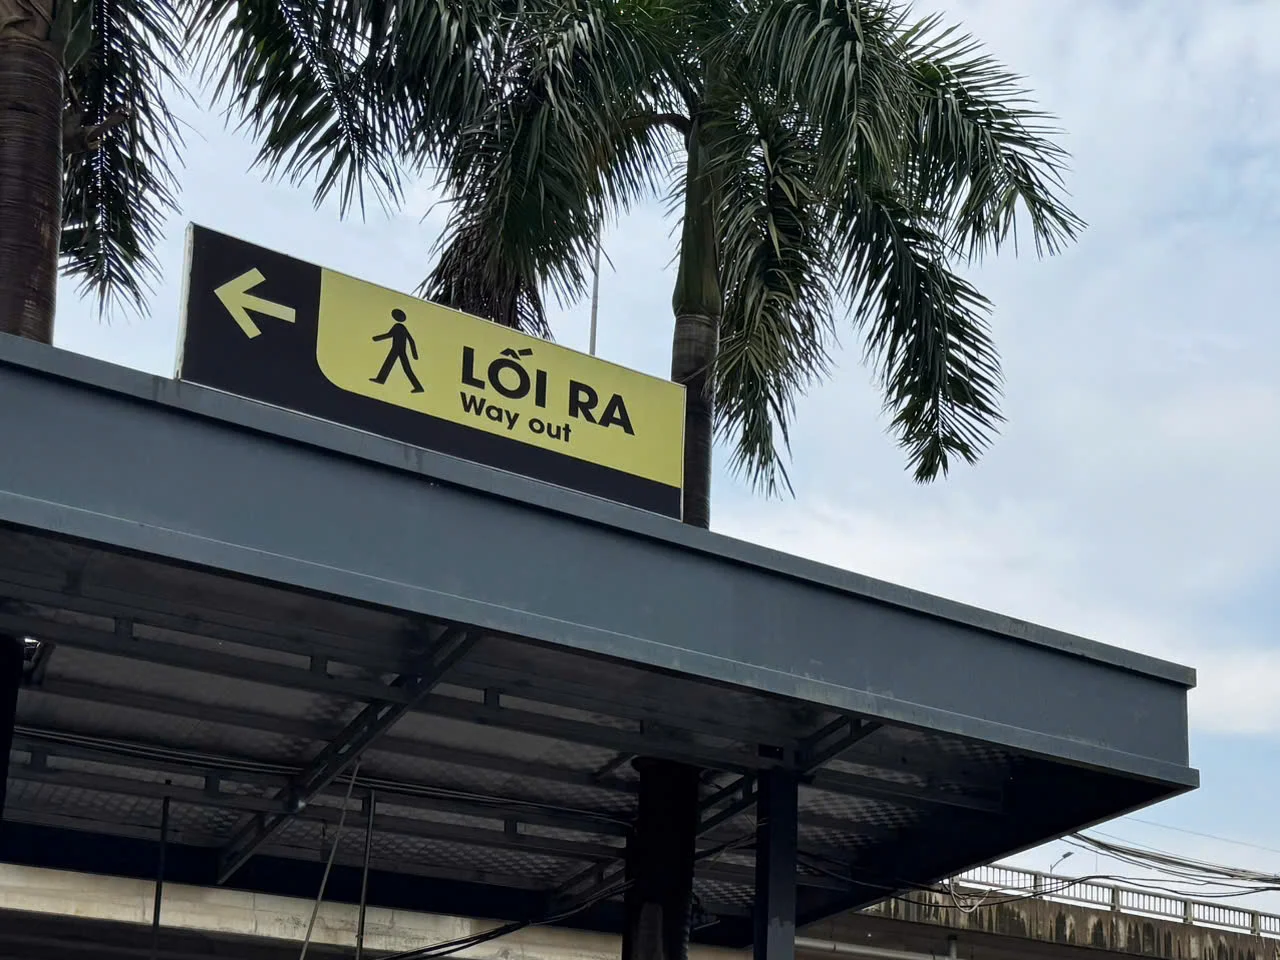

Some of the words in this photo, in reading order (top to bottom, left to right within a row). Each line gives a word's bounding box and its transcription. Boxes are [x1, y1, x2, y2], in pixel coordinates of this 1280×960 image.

[460, 346, 549, 409] LỐI
[568, 379, 636, 436] RA
[460, 391, 520, 431] Way
[528, 415, 573, 443] out
